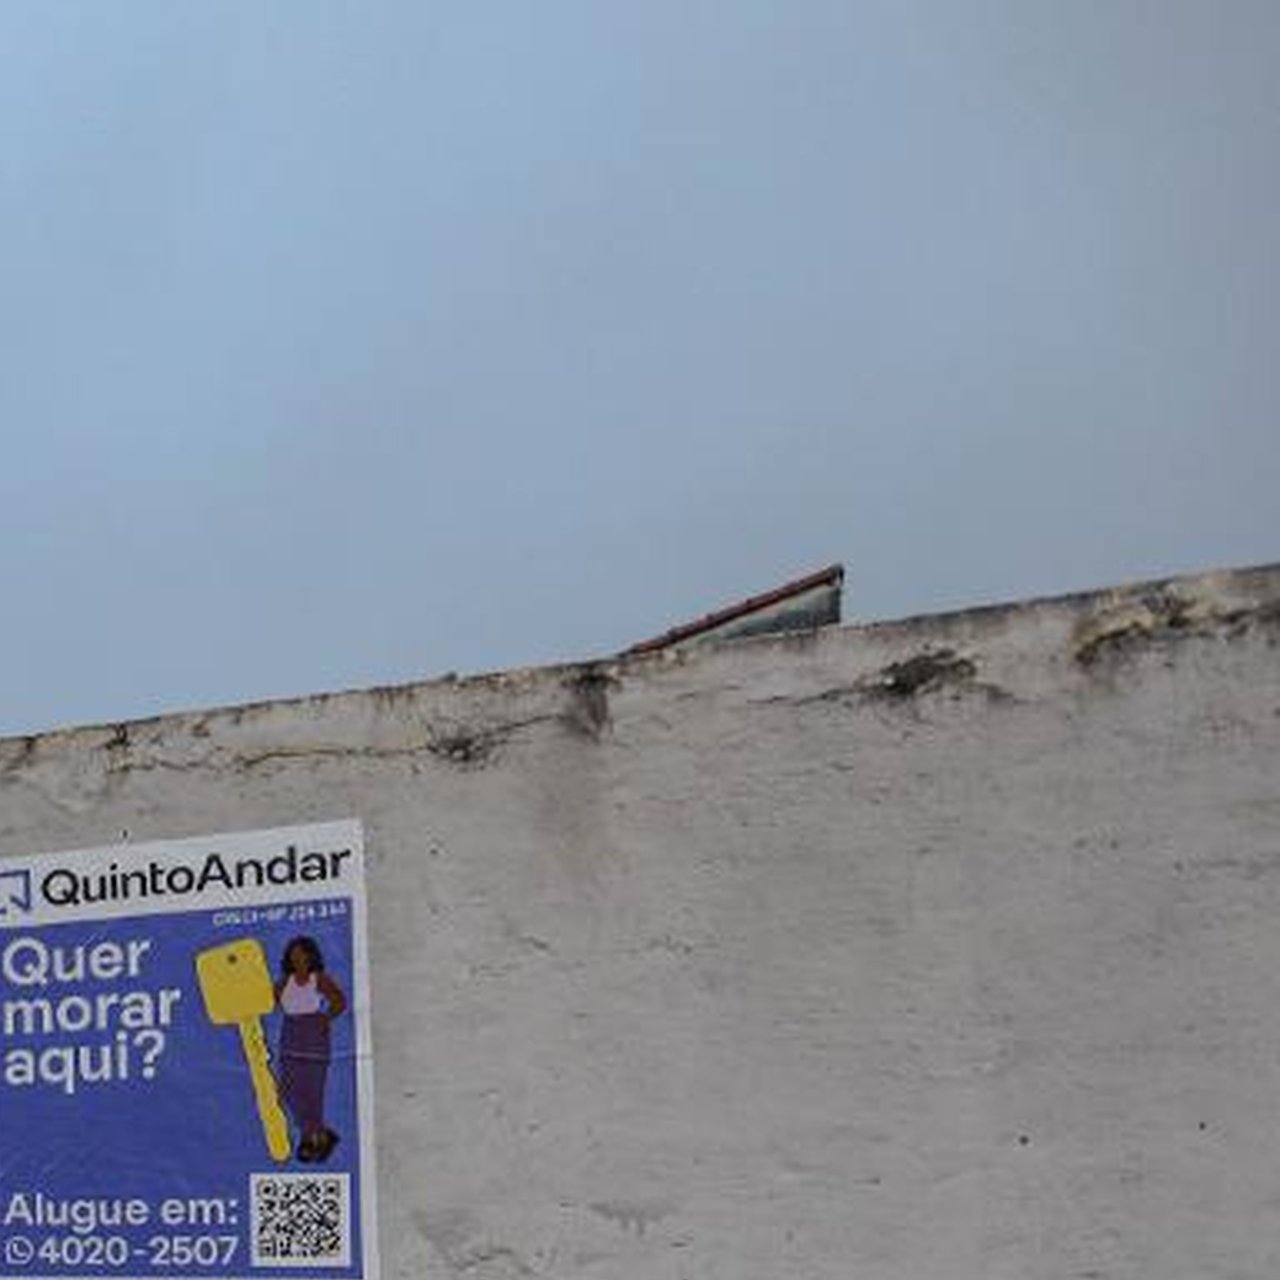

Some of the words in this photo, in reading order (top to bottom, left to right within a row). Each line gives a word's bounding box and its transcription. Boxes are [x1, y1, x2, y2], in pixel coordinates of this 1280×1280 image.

[41, 845, 352, 906] QuintoAndar
[2, 937, 151, 986] Quer
[2, 988, 182, 1035] morar
[4, 1029, 165, 1094] aqui?
[3, 1192, 149, 1234] Alugue
[160, 1197, 239, 1225] em:
[39, 1235, 239, 1265] 4020-2507
